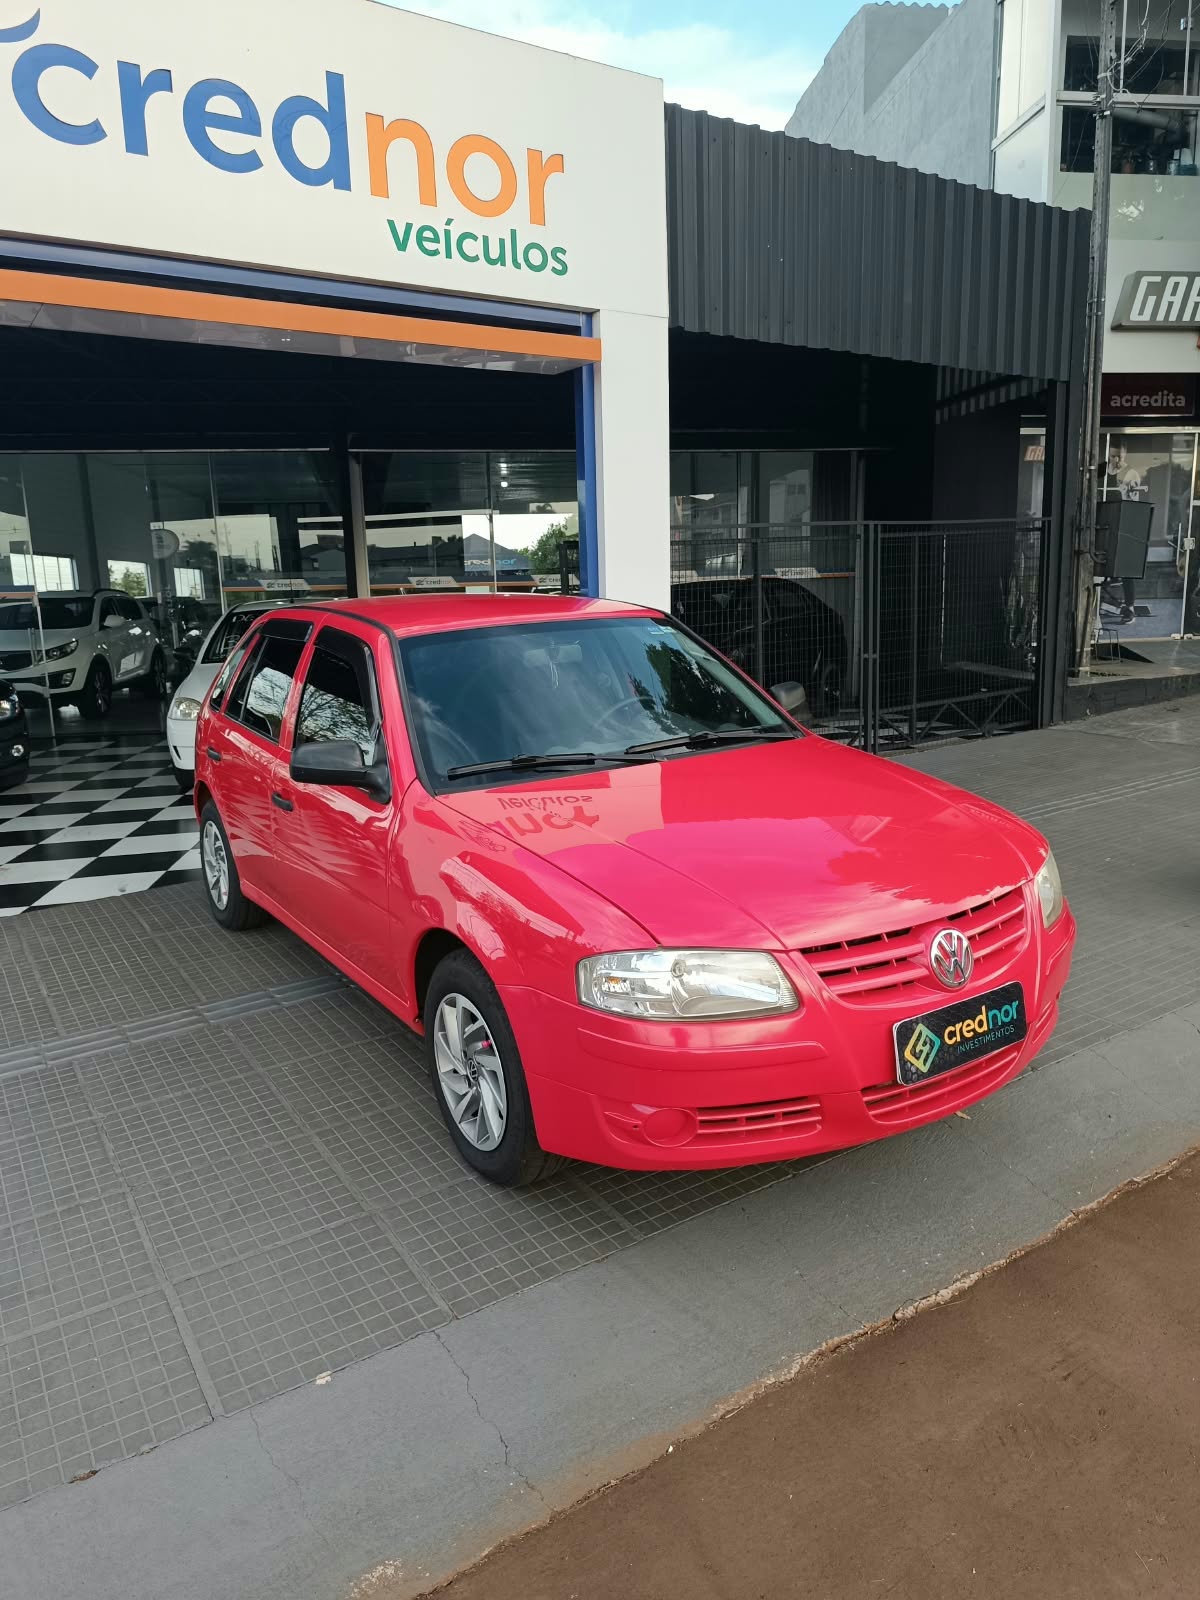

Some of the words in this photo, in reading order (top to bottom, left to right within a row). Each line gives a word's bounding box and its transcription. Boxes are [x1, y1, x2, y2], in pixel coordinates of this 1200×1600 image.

[11, 43, 565, 227] crednor
[386, 217, 569, 276] veículos
[1110, 390, 1186, 407] acredita
[1023, 445, 1045, 461] GA
[943, 1000, 1019, 1045] crednor
[956, 1024, 1015, 1054] INVESTIMENTOS
